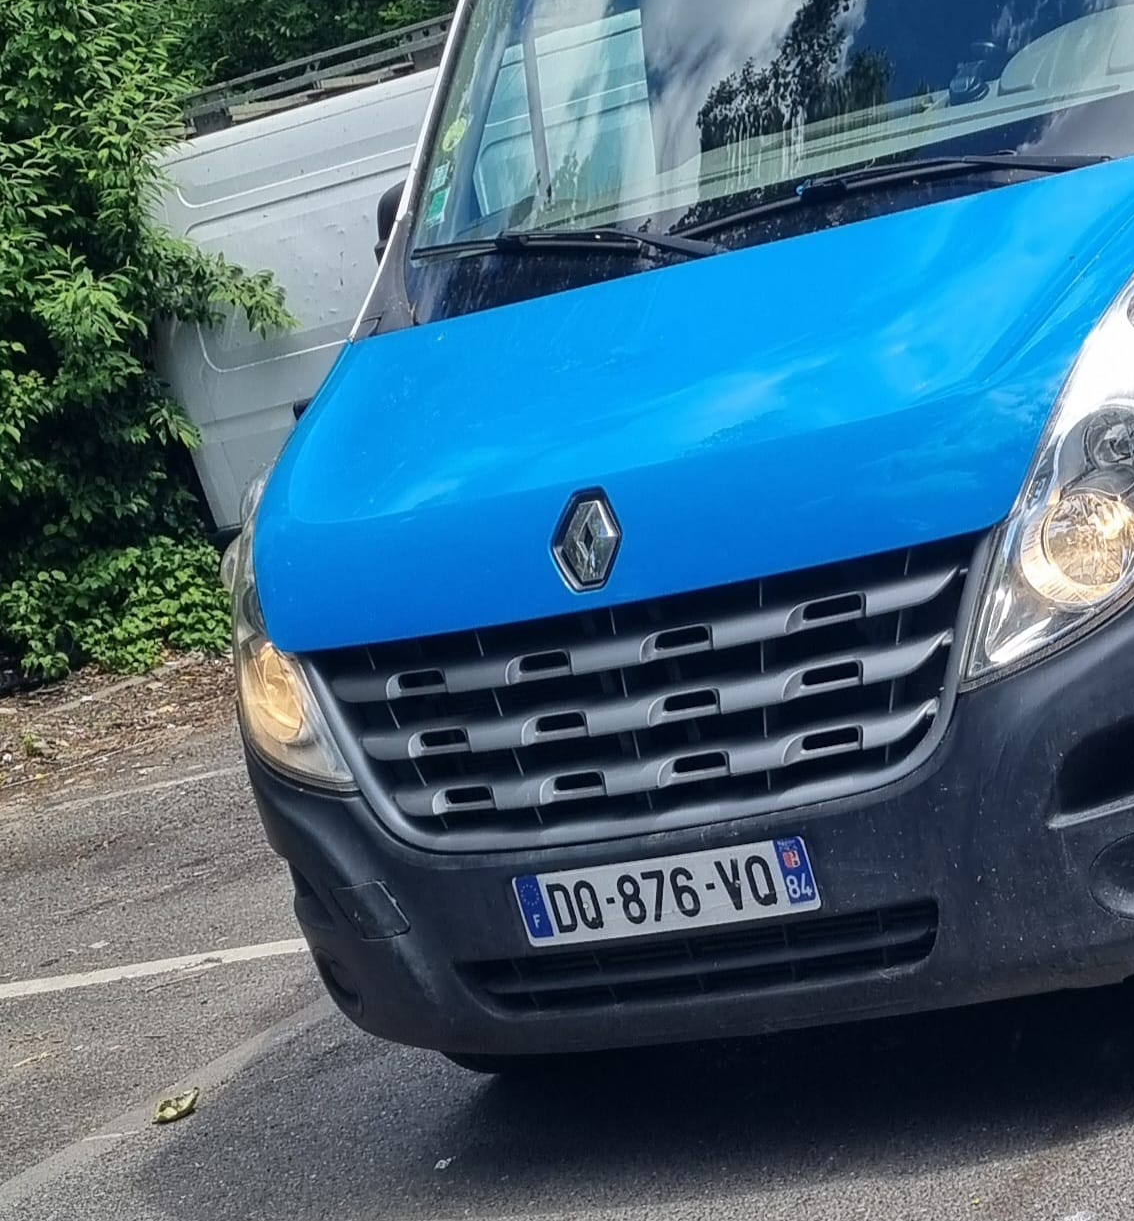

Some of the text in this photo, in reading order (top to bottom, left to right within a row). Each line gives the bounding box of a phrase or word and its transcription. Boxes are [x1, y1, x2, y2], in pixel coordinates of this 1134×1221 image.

[546, 855, 777, 933] DQ-876-VQ
[786, 873, 812, 898] 84
[532, 914, 541, 929] F
